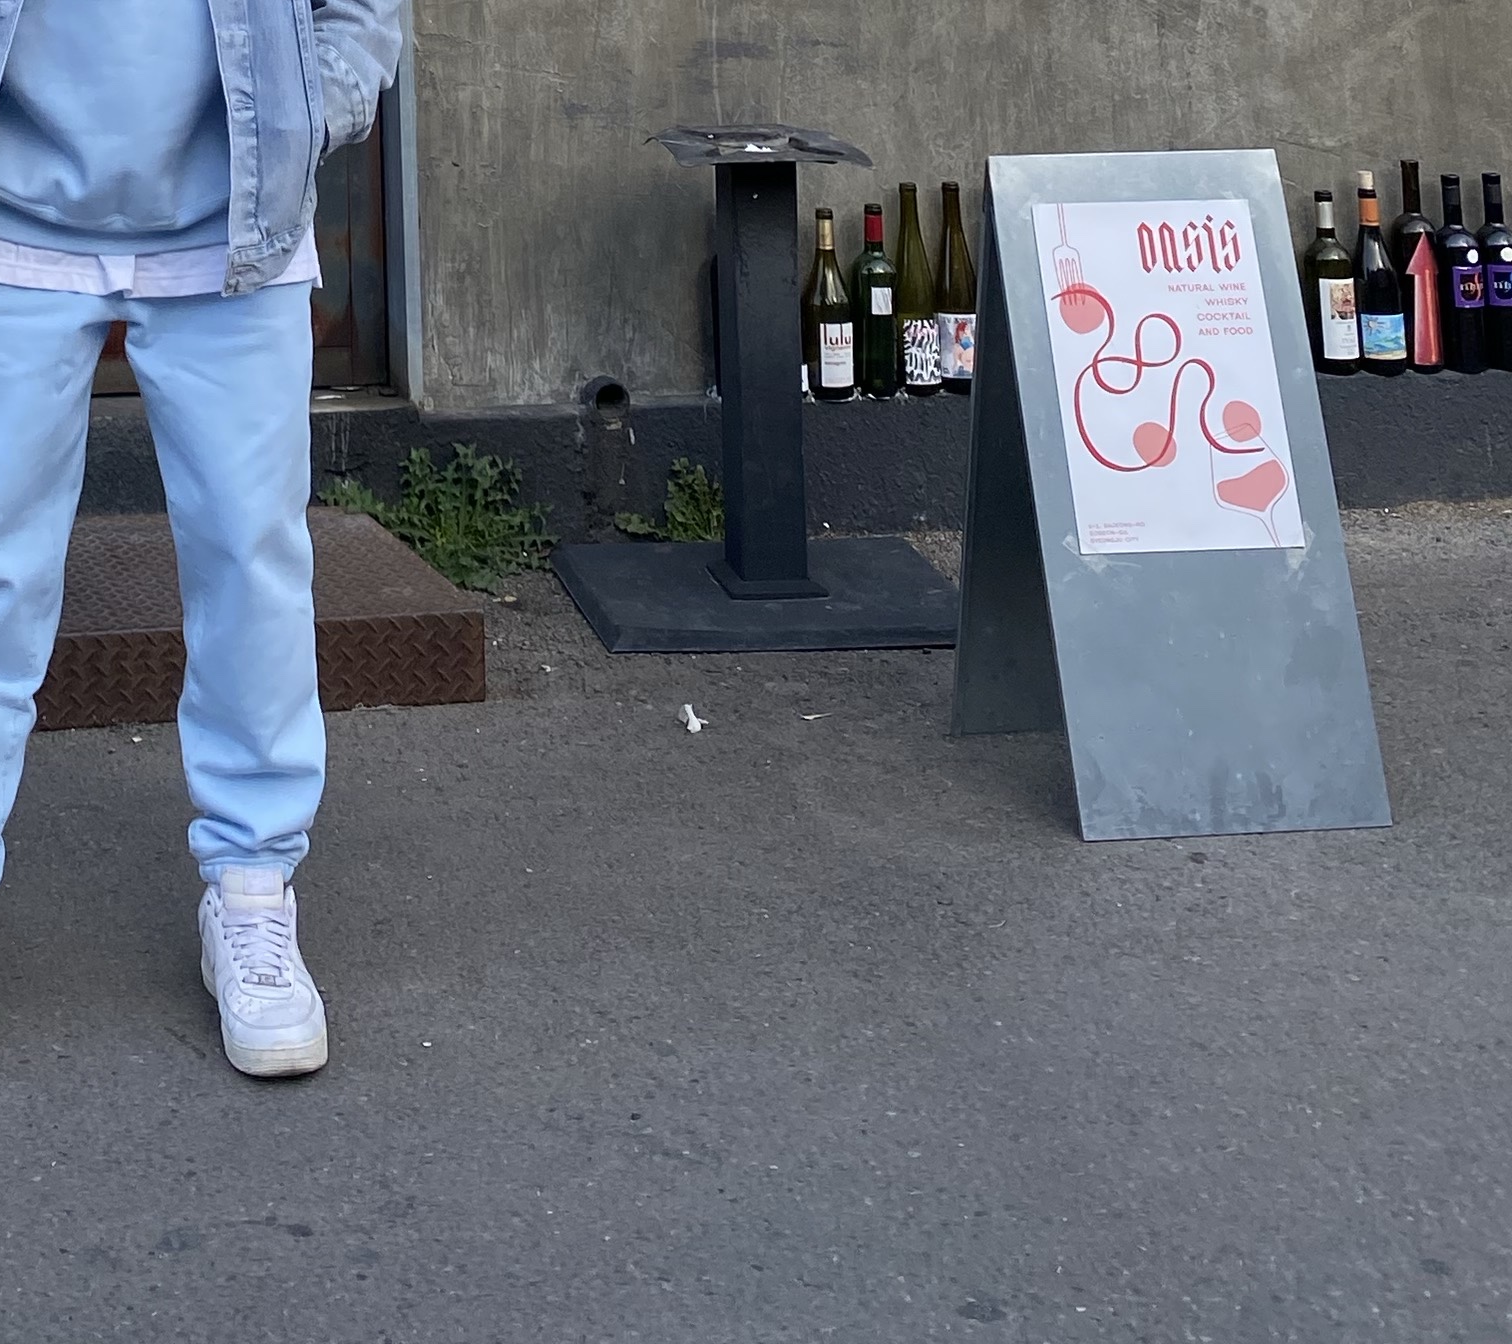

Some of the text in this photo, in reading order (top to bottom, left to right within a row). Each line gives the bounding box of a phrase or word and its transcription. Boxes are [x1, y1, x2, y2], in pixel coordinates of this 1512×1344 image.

[1168, 282, 1246, 293] NATURAL WINE
[1205, 297, 1248, 307] WHISKY
[1197, 312, 1251, 322] COCKTAIL
[1198, 326, 1253, 336] AND FOOD
